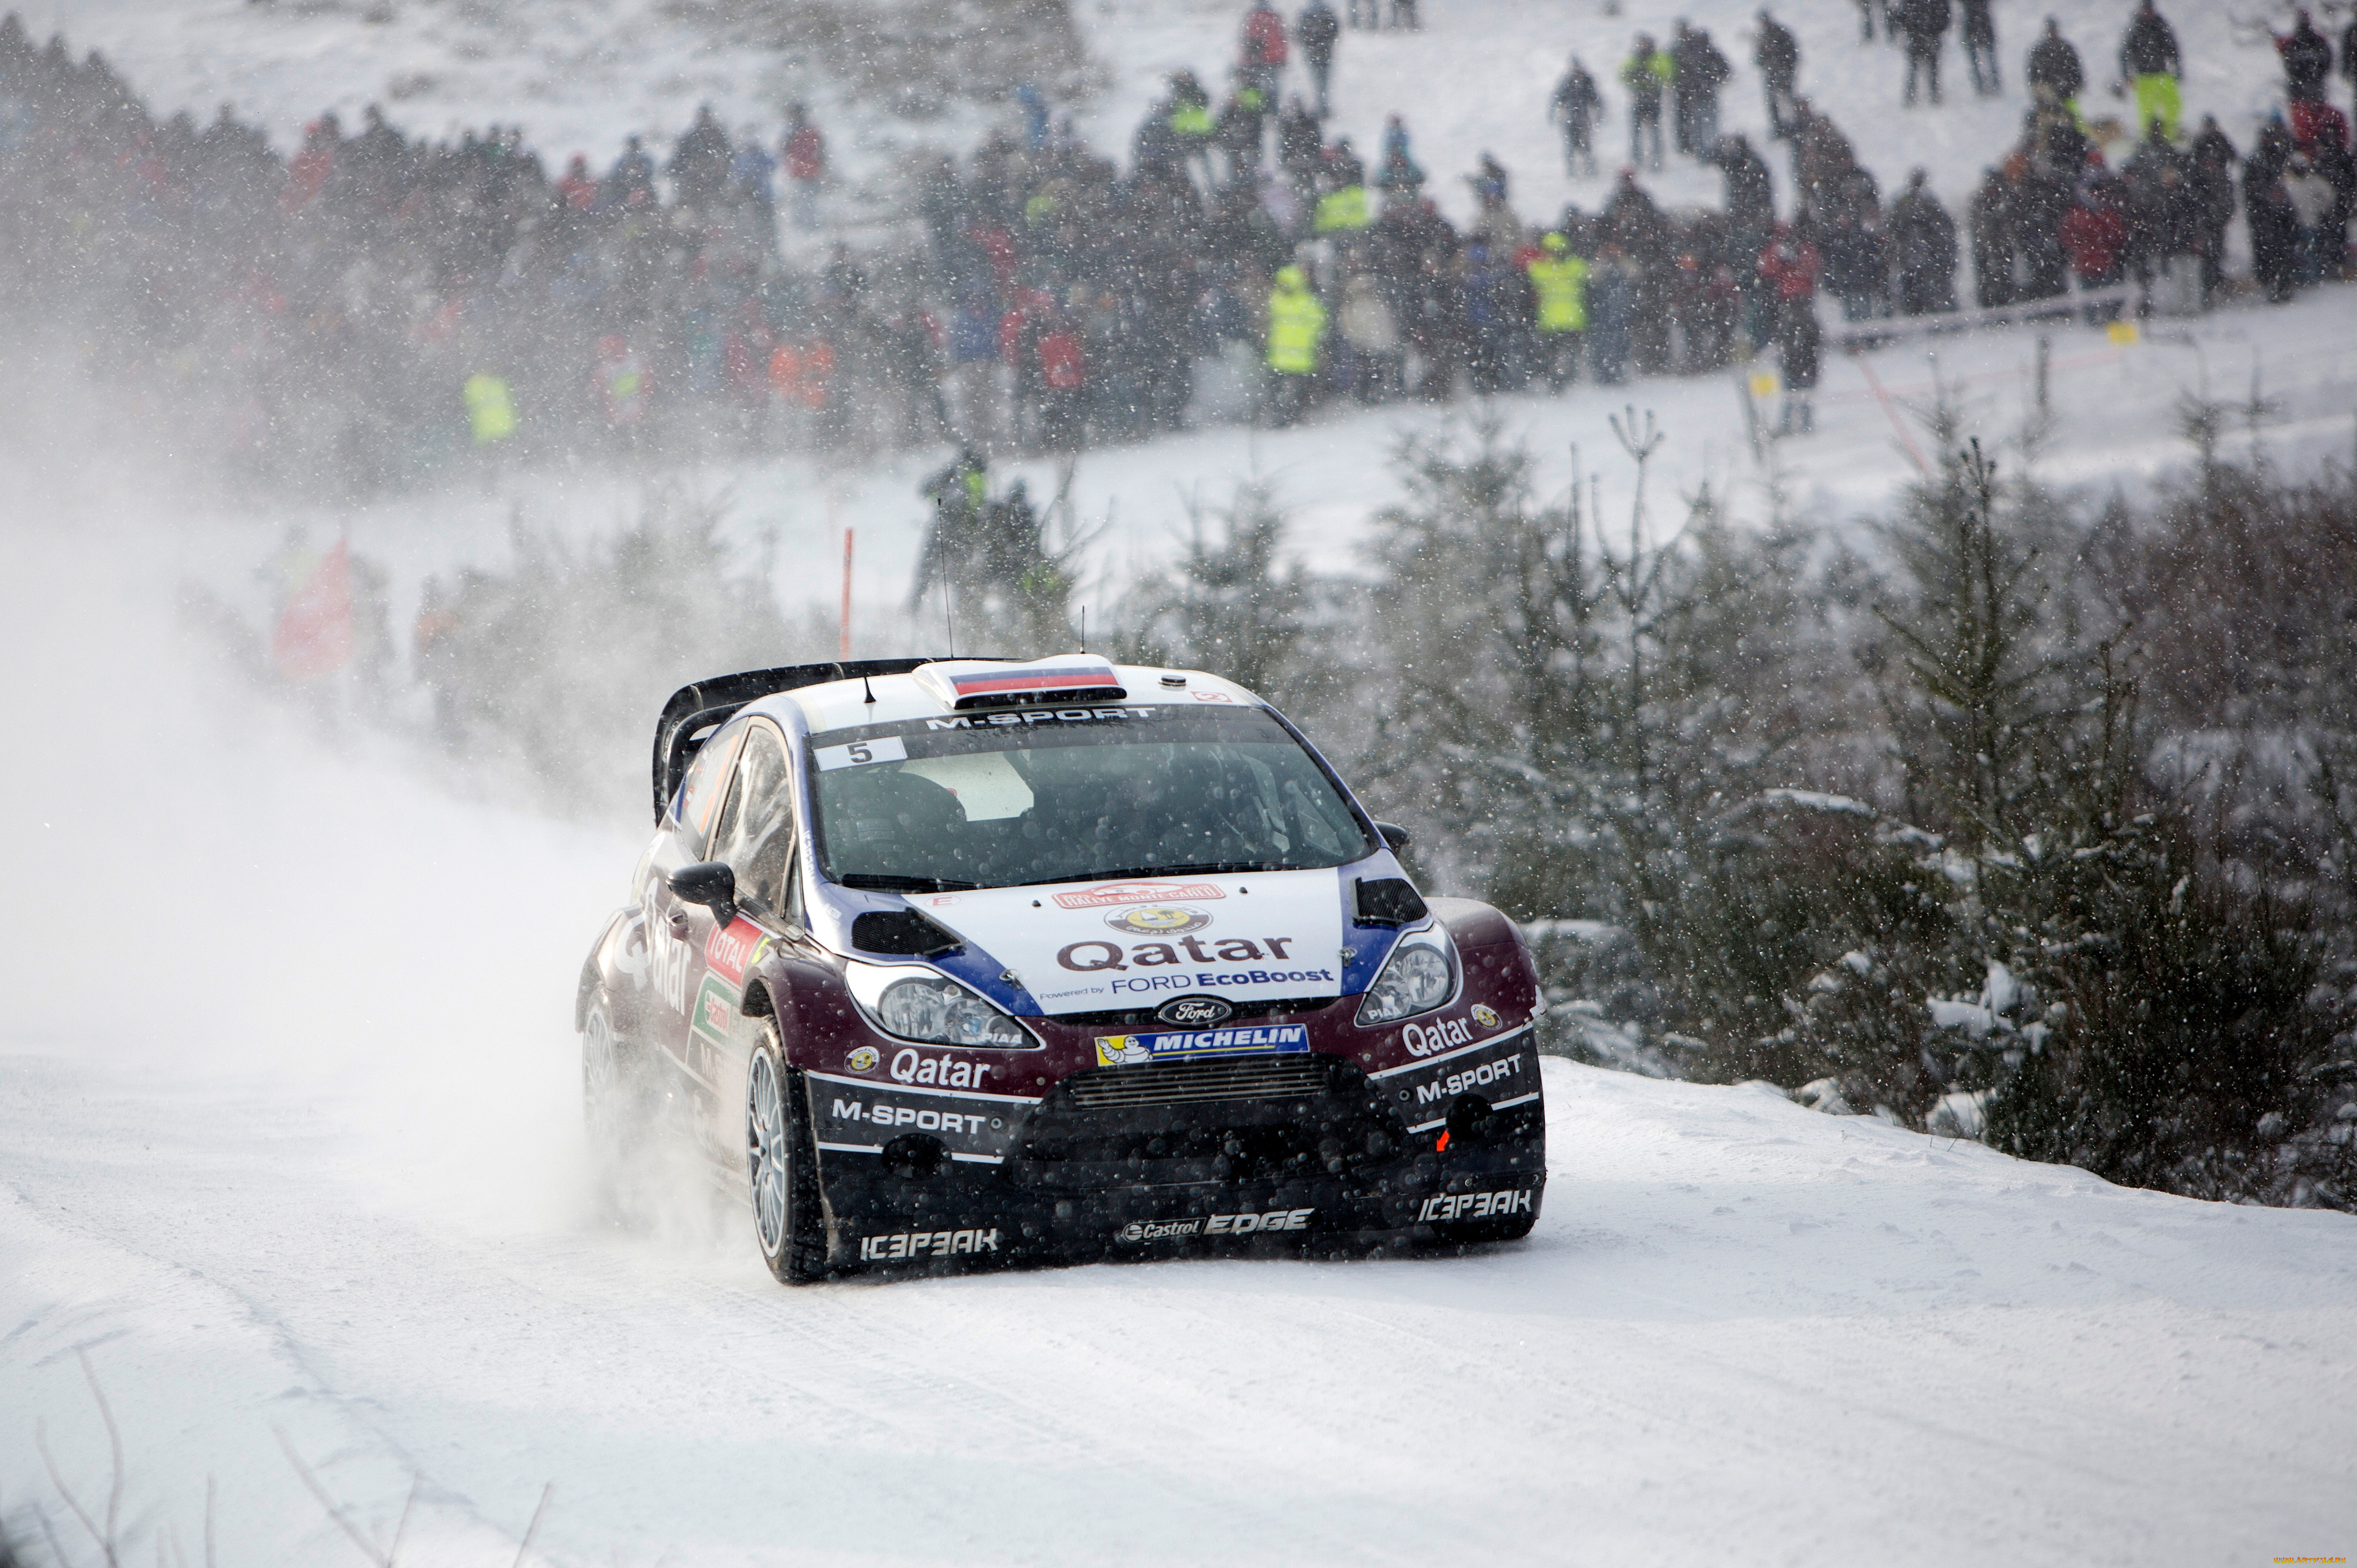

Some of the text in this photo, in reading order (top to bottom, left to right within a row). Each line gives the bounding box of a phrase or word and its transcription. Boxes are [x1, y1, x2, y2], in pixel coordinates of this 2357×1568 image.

[925, 708, 1156, 730] M-SPORT
[847, 742, 872, 763] 5
[932, 896, 953, 906] E
[709, 927, 747, 973] TOTAL
[1056, 935, 1292, 971] Qatar
[1039, 969, 1334, 1000] Powered by FORD EcoBoost
[1175, 1003, 1216, 1020] Ford
[1366, 1004, 1402, 1020] PIAA
[980, 1031, 1022, 1044] PIAA
[1154, 1028, 1301, 1050] MICHELIN
[1402, 1016, 1474, 1057] Qatar
[890, 1048, 991, 1088] Qatar
[1416, 1054, 1522, 1105] M-SPORT
[832, 1098, 986, 1134] M-SPORT
[1142, 1208, 1316, 1240] Castrol EDGE
